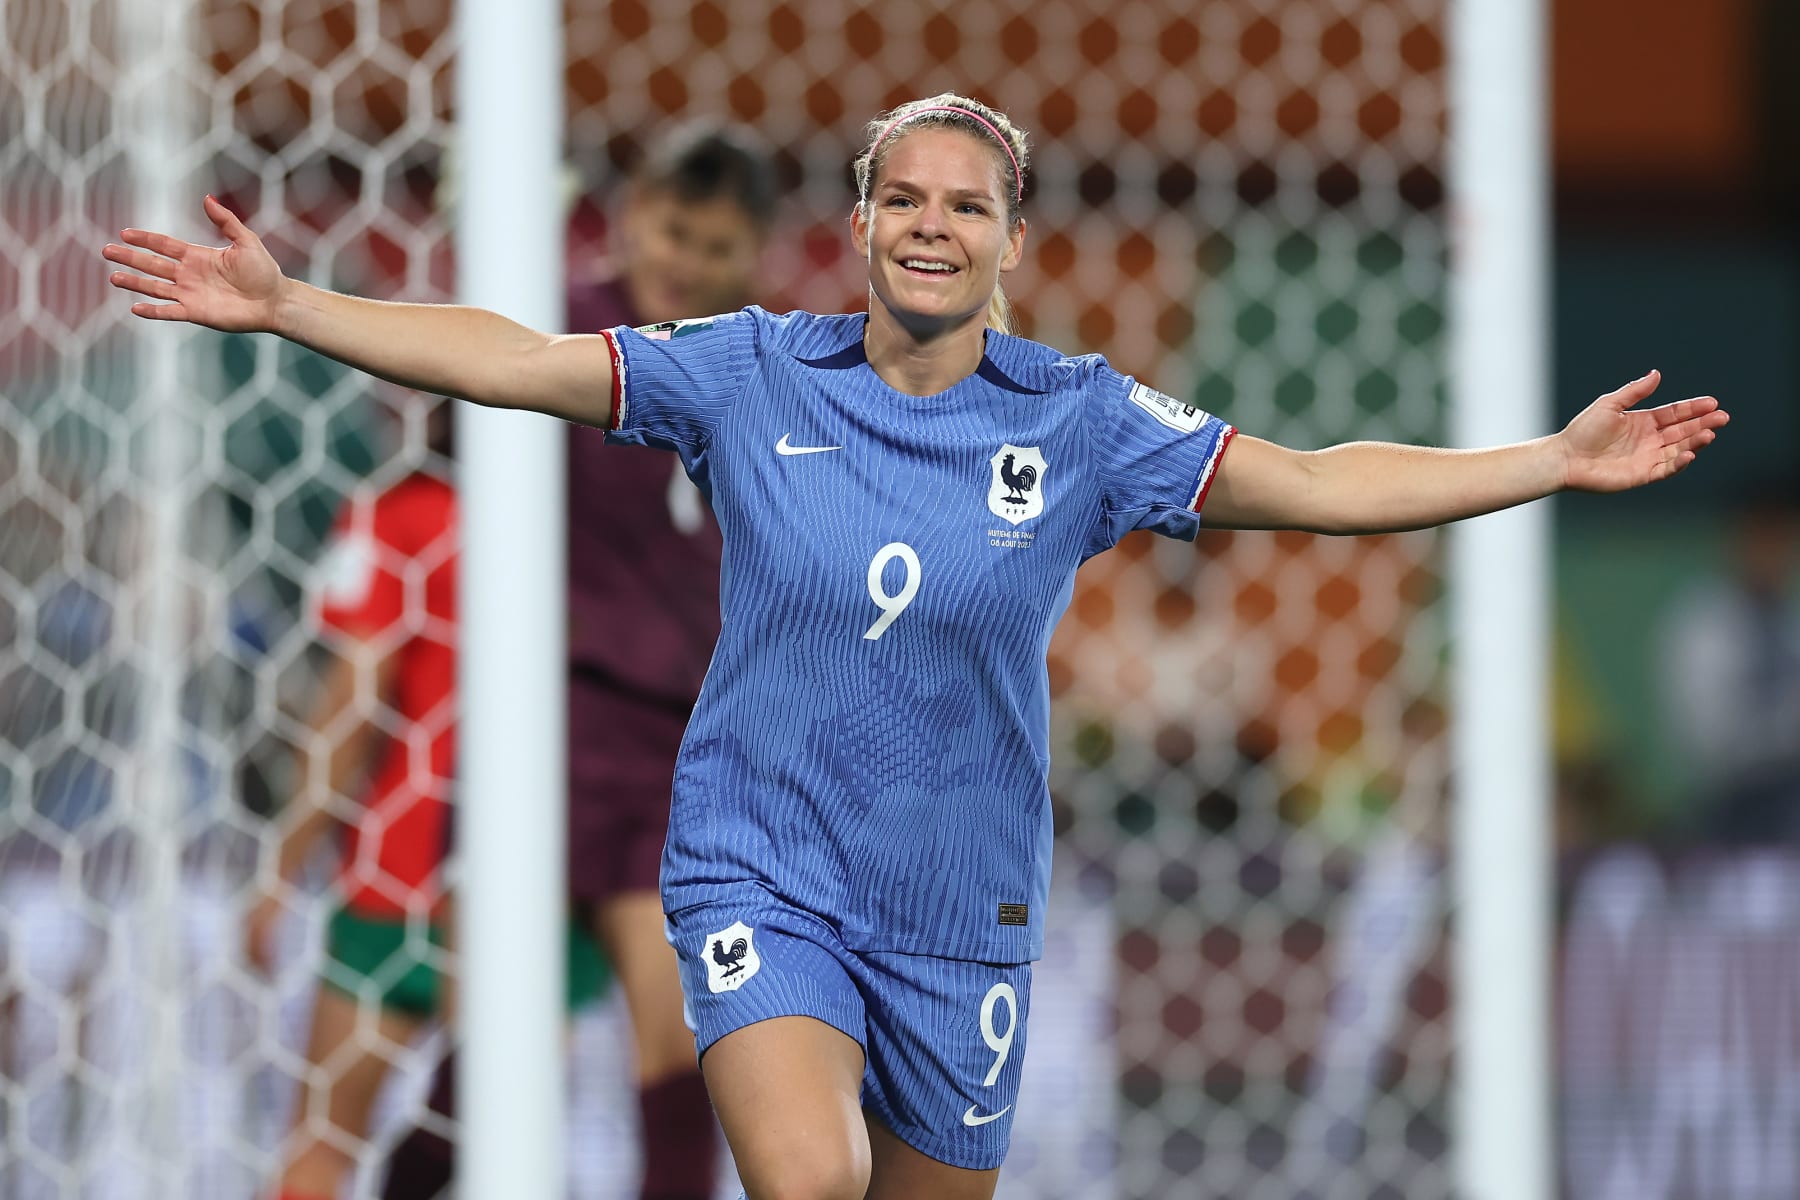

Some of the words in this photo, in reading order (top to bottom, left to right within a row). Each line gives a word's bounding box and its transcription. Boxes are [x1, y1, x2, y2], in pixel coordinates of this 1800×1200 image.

[1013, 531, 1020, 539] DE
[863, 542, 921, 641] 9
[979, 982, 1017, 1087] 9
